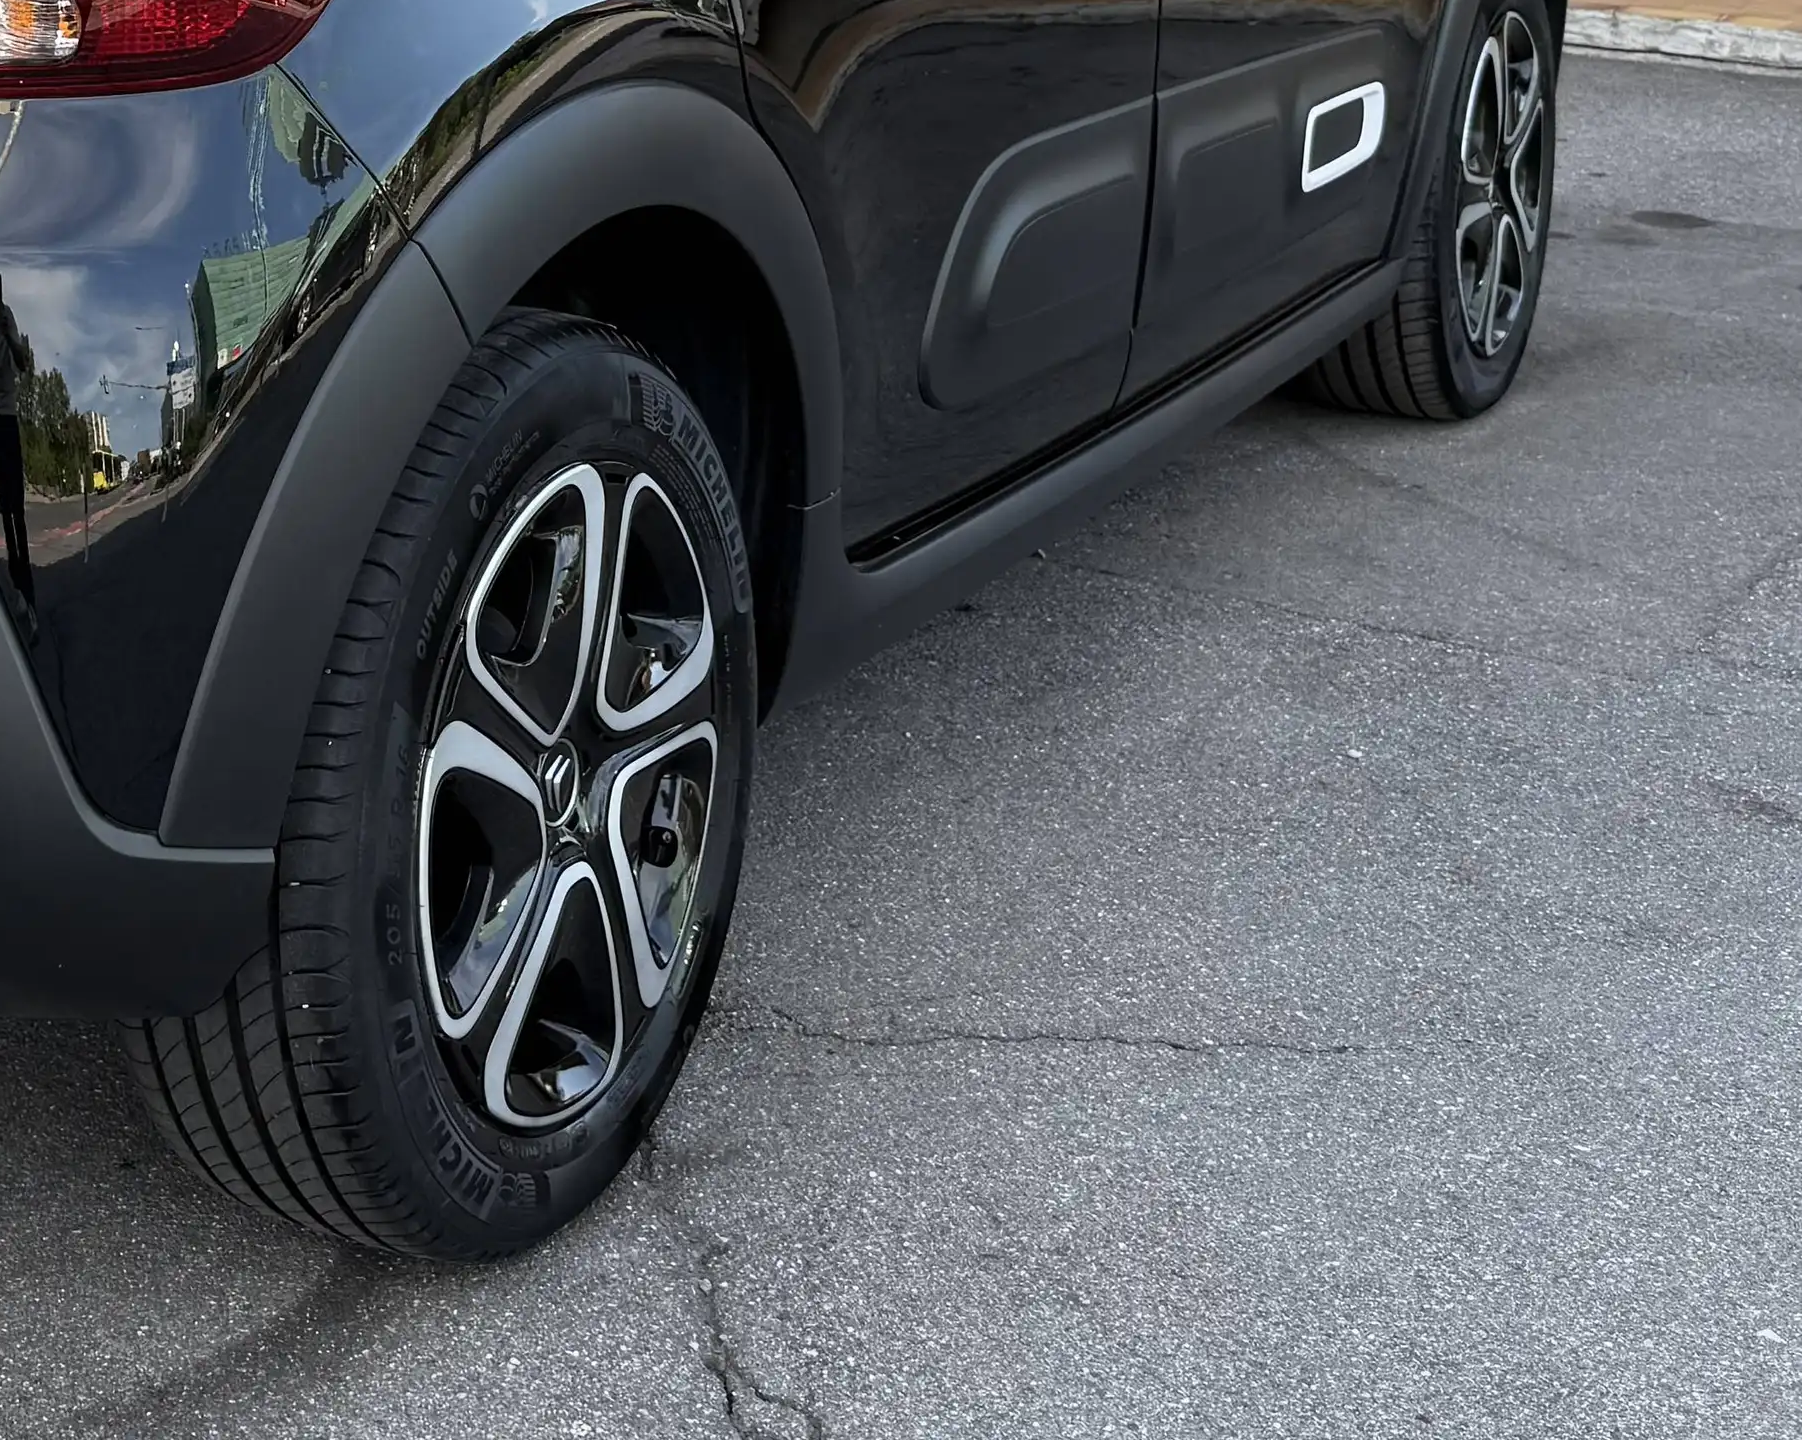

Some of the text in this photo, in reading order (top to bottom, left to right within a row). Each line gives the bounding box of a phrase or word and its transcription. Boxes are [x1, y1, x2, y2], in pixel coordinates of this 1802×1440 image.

[677, 412, 748, 601] MICHELIN
[416, 550, 458, 659] OUTSIDE
[394, 1013, 495, 1206] MICHN
